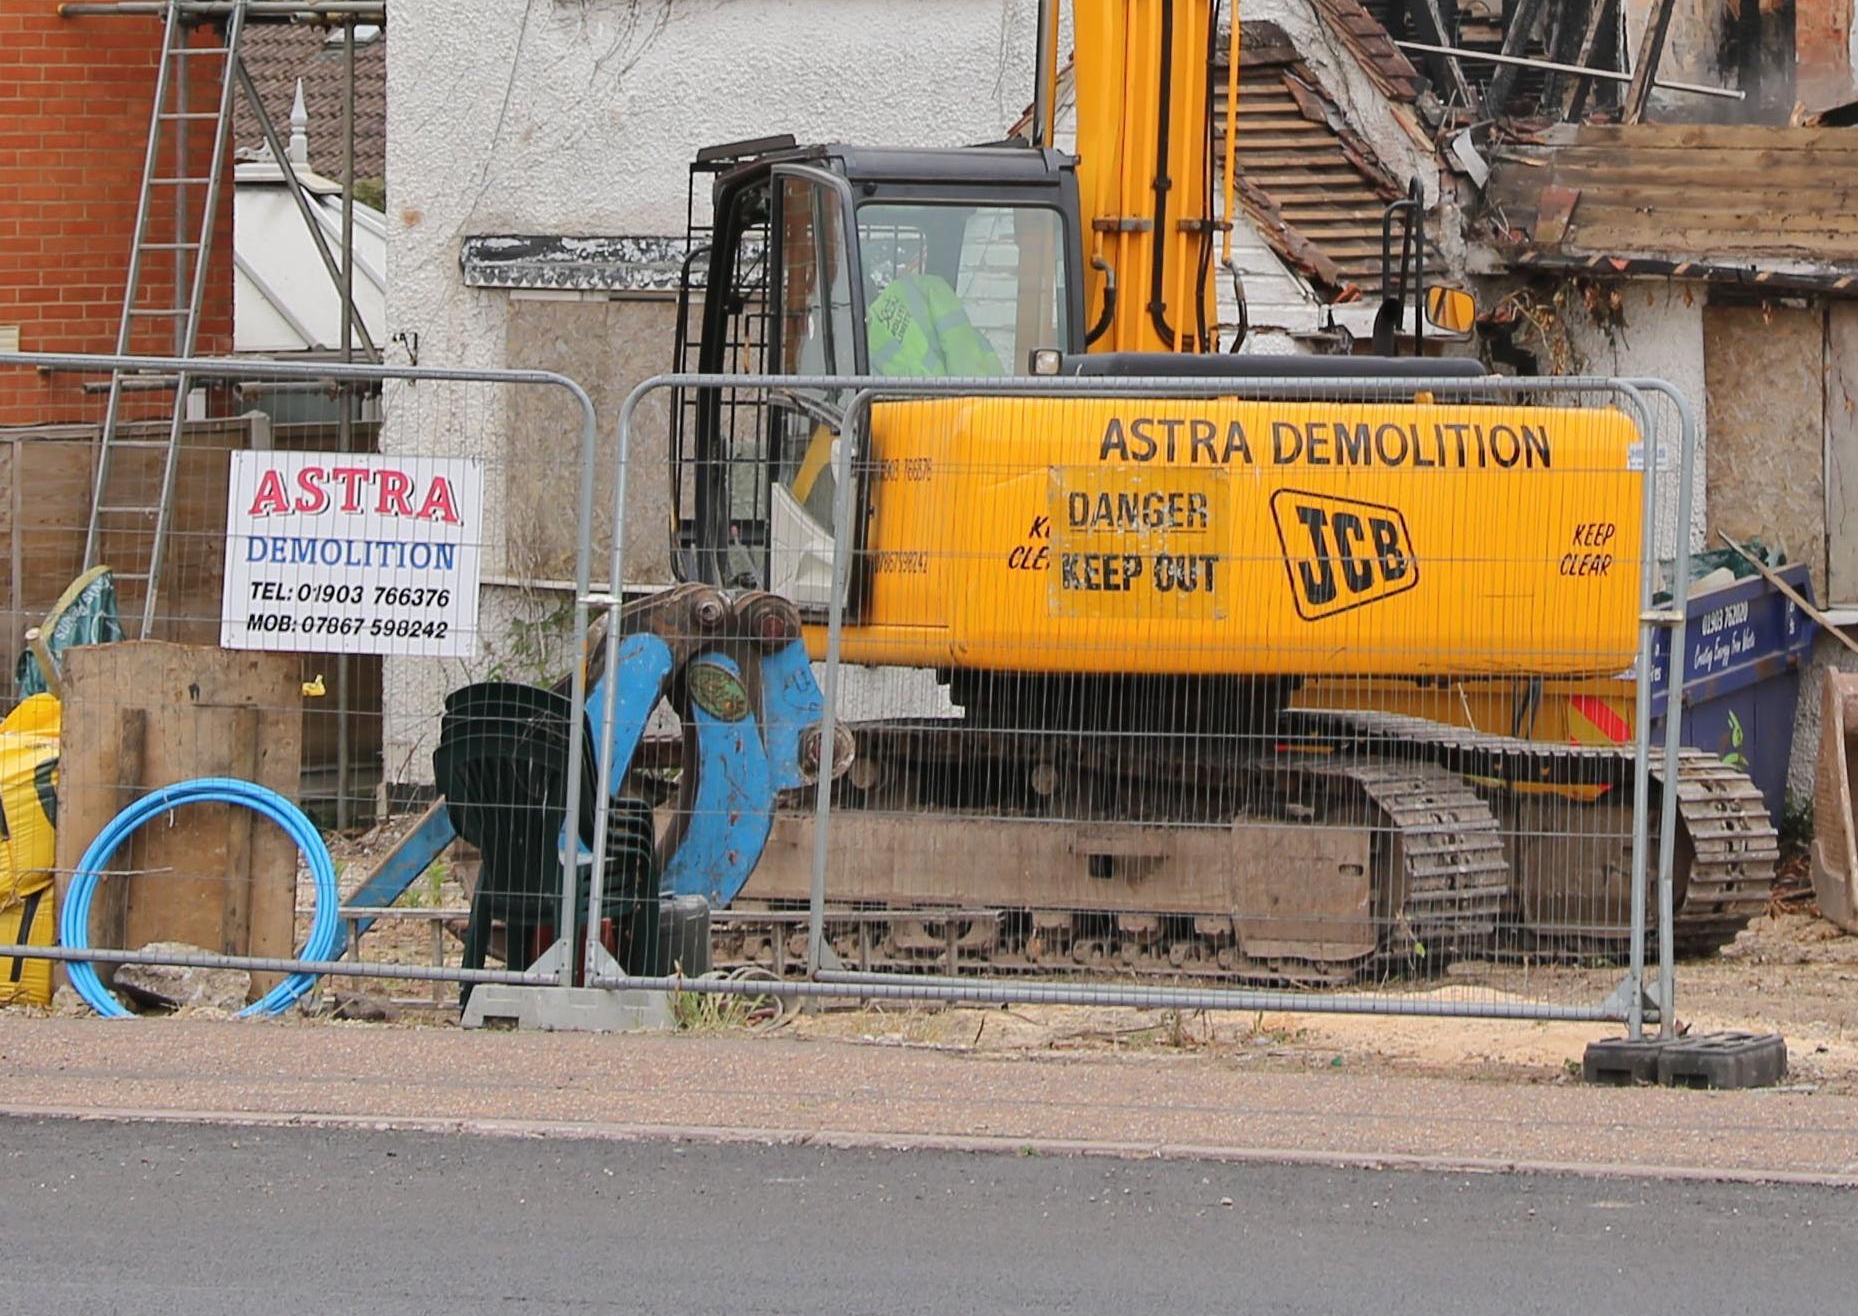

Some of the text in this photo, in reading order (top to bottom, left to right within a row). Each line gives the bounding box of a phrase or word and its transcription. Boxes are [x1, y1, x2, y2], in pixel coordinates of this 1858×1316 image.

[1099, 418, 1551, 469] ASTRA DEMOLITION
[247, 466, 465, 527] ASTRA
[1069, 491, 1208, 529] DANGER
[245, 535, 457, 571] DEMOLITION
[1573, 523, 1616, 547] KEEP
[1008, 546, 1050, 571] CLE
[1061, 553, 1220, 593] KEEP OUT
[1296, 505, 1409, 606] JCB
[1559, 553, 1613, 578] CLEAR
[250, 581, 450, 607] TEL: 01903 766376
[246, 614, 449, 640] MOB: 07867 598242
